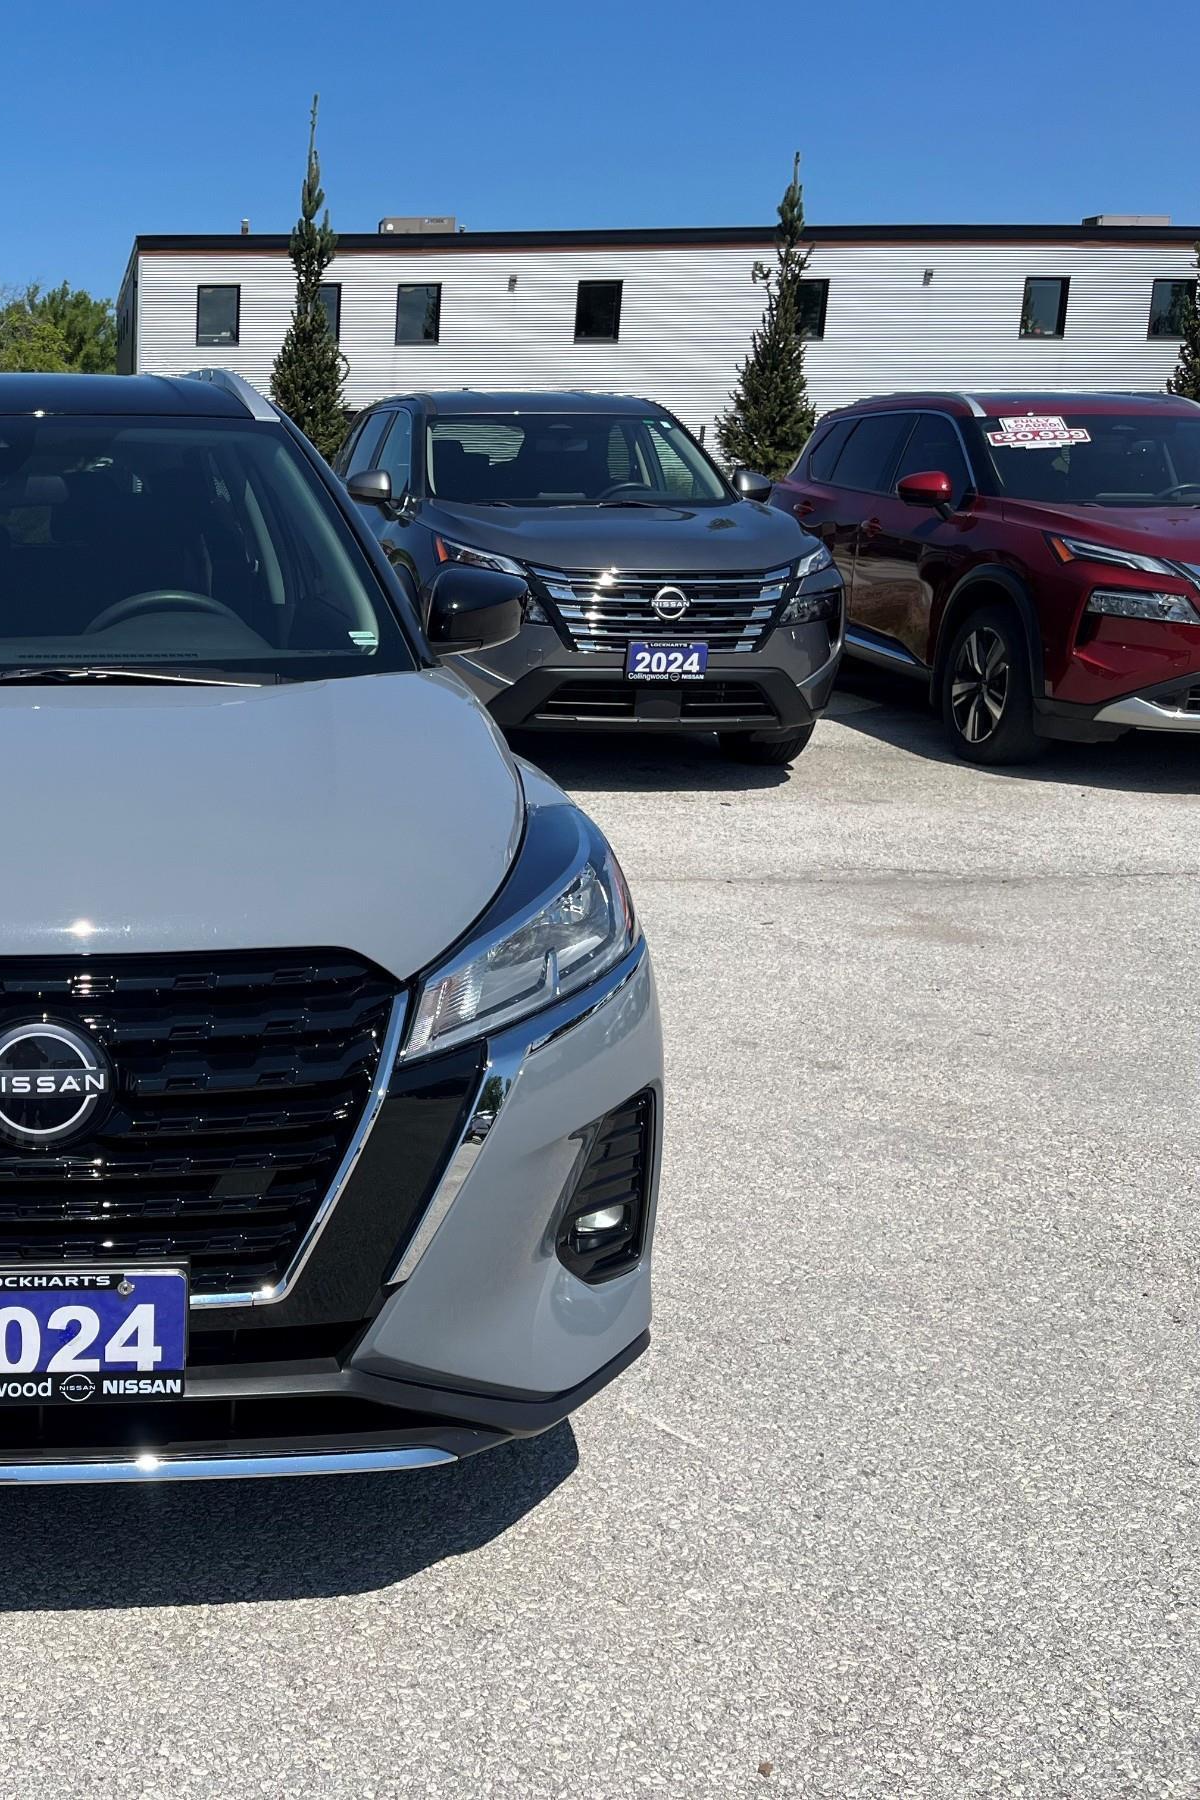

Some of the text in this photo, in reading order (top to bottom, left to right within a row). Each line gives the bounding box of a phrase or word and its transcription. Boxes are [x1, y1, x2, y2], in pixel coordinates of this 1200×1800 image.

[634, 652, 700, 673] 2024
[628, 672, 669, 681] Collingwood
[58, 1384, 96, 1392] NISSAN
[102, 1379, 182, 1395] NISSAN
